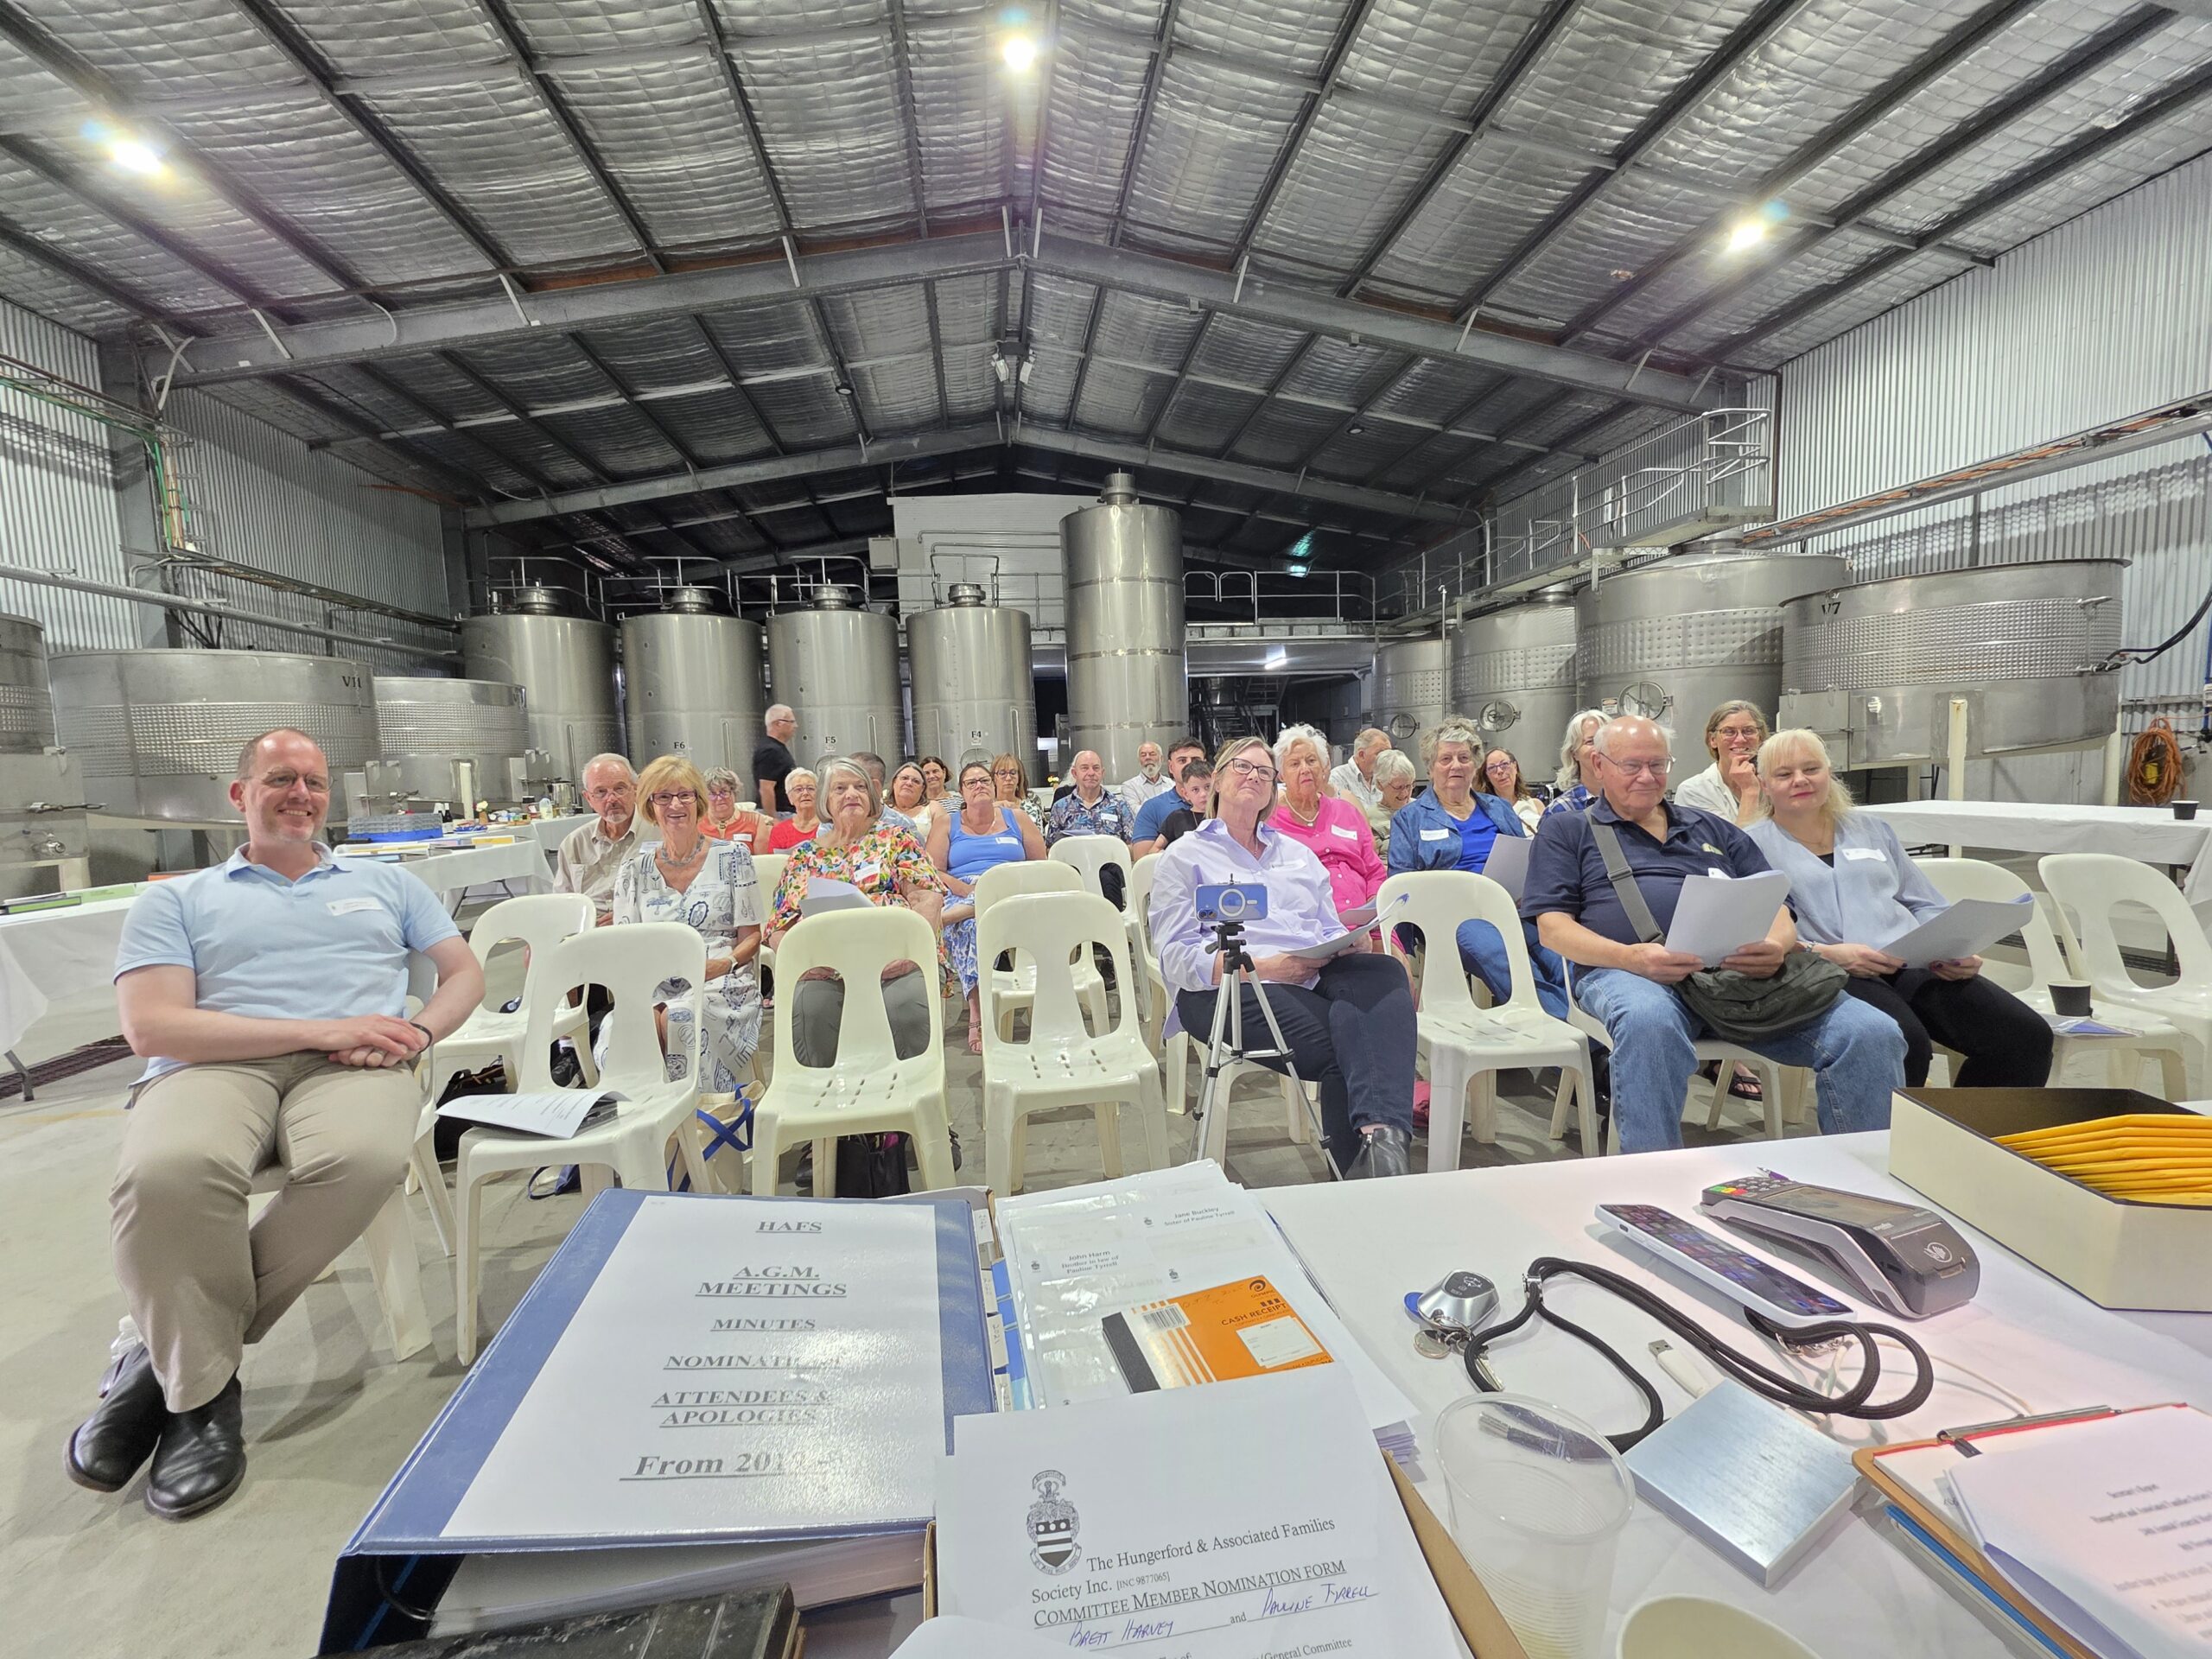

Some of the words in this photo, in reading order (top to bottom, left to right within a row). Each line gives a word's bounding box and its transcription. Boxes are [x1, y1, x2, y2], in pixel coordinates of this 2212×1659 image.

[1821, 601, 1841, 615] V7
[824, 735, 836, 744] F5
[758, 1221, 822, 1231] HAFS
[734, 1266, 820, 1278] A.G.M.
[698, 1282, 847, 1295] MEETINGS
[1221, 1313, 1249, 1326] CASH
[1249, 1302, 1287, 1319] RECEIPT
[712, 1319, 816, 1330] MINUTES
[653, 1390, 808, 1405] ATTENDEES
[661, 1409, 817, 1425] APOLOGIES
[634, 1456, 724, 1476] From
[1086, 1557, 1114, 1573] The
[1117, 1541, 1193, 1568] Hungerford
[1197, 1539, 1209, 1554] &
[1212, 1526, 1280, 1550] Associated
[1281, 1518, 1336, 1538] Families
[1032, 1583, 1082, 1604] Society
[1085, 1580, 1113, 1595] Inc.
[1116, 1576, 1135, 1592] [INC
[1135, 1571, 1171, 1588] 9877065]
[1034, 1598, 1130, 1627] COMMITTEE
[1132, 1586, 1199, 1611] MEMBER
[1202, 1567, 1302, 1597] NOMINATION
[1304, 1560, 1346, 1580] FORM
[1230, 1611, 1247, 1625] and
[1069, 1619, 1114, 1648] BRETT
[1122, 1618, 1174, 1641] HARVEY
[1302, 1638, 1353, 1656] Committee
